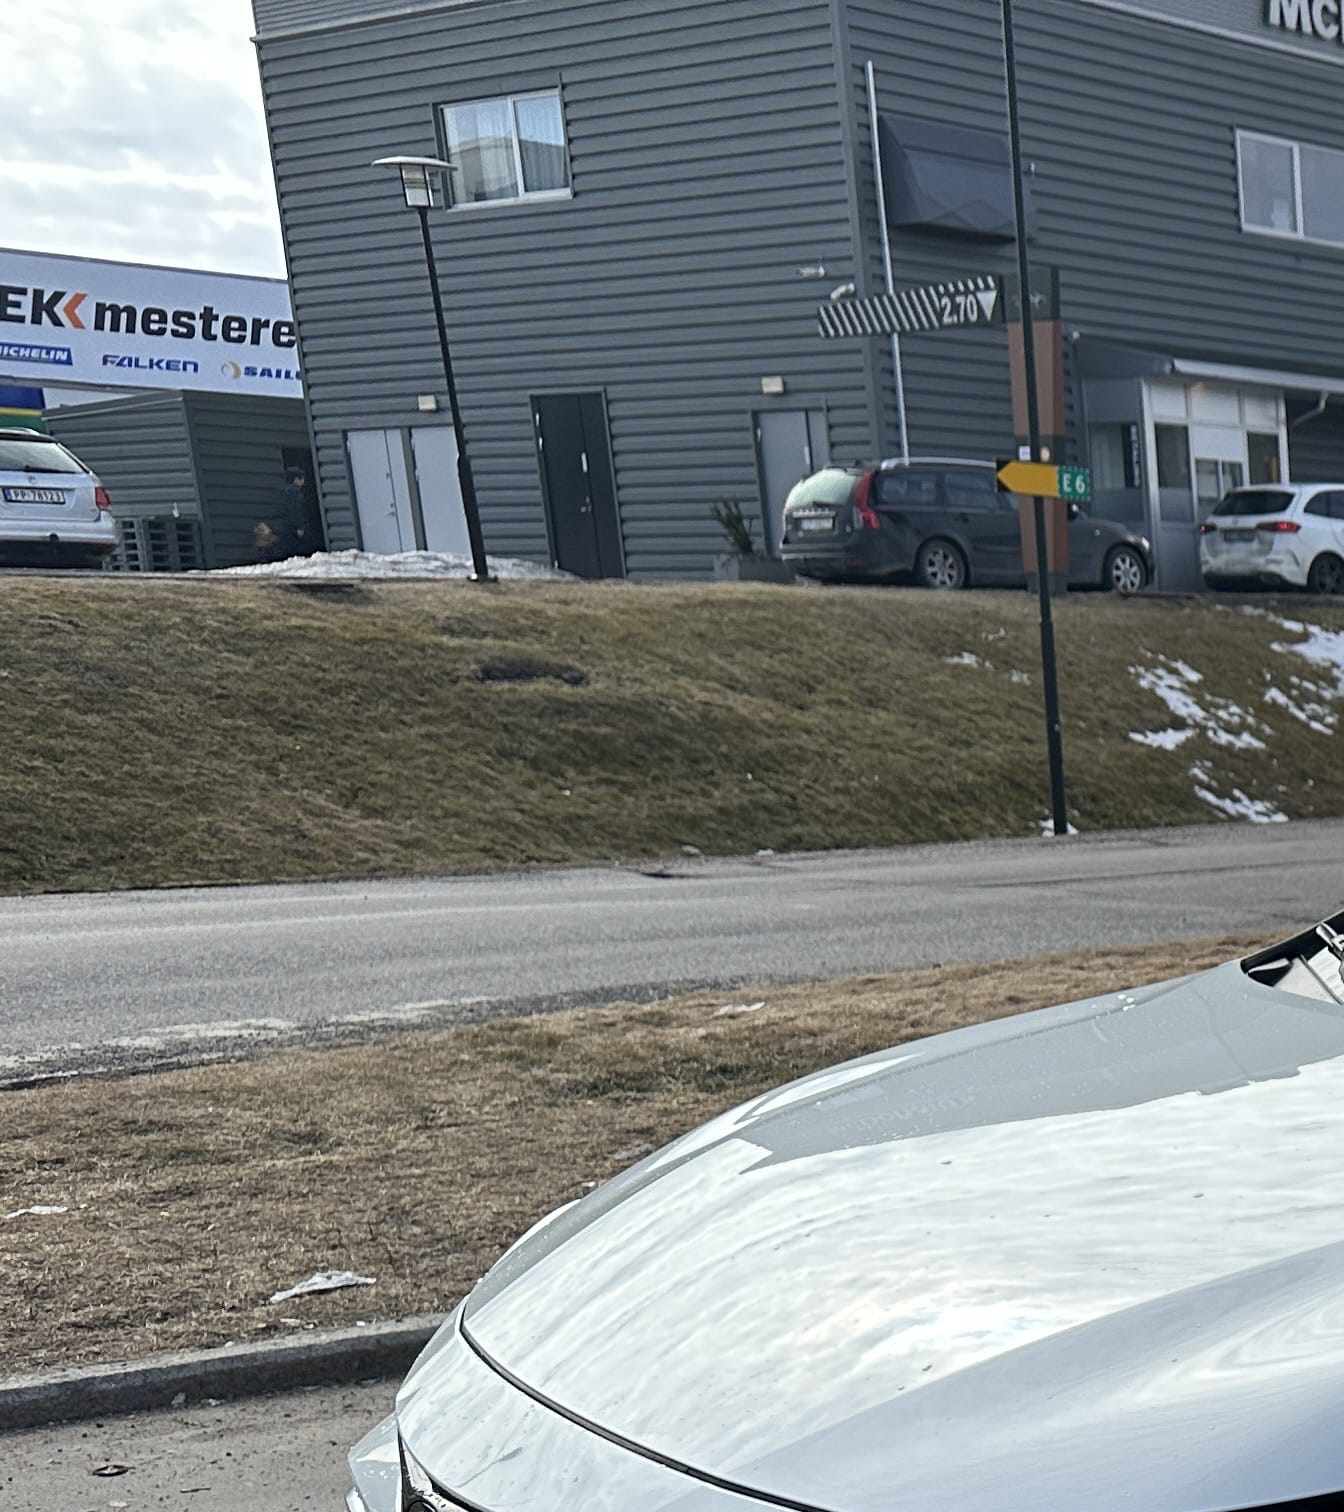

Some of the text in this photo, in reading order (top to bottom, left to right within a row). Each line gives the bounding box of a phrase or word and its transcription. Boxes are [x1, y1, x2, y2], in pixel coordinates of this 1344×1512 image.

[941, 294, 978, 326] 2.70
[0, 345, 68, 360] ICHELIN
[102, 354, 199, 373] FALKEN
[1062, 473, 1086, 495] E 6
